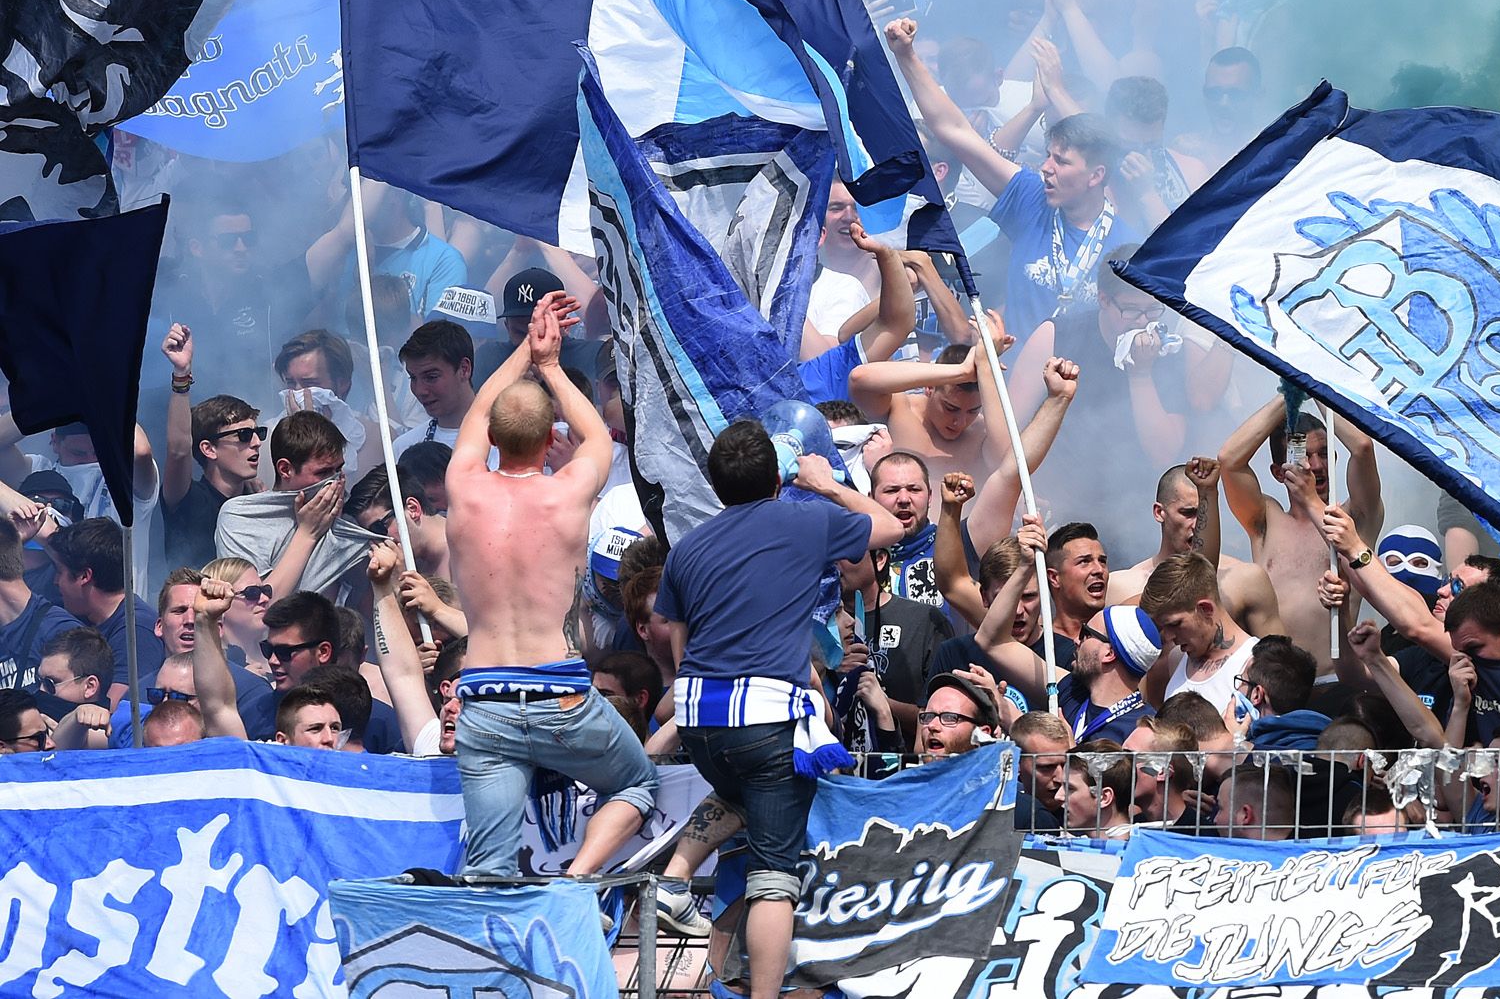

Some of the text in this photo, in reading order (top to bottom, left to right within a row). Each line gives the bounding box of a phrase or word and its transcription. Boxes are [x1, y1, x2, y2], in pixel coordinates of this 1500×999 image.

[457, 291, 477, 306] 1860
[610, 534, 627, 546] TSV
[1127, 843, 1458, 910] FREIHEIT FÜR
[1107, 914, 1199, 966] DIE
[1173, 900, 1435, 984] JUNGS
